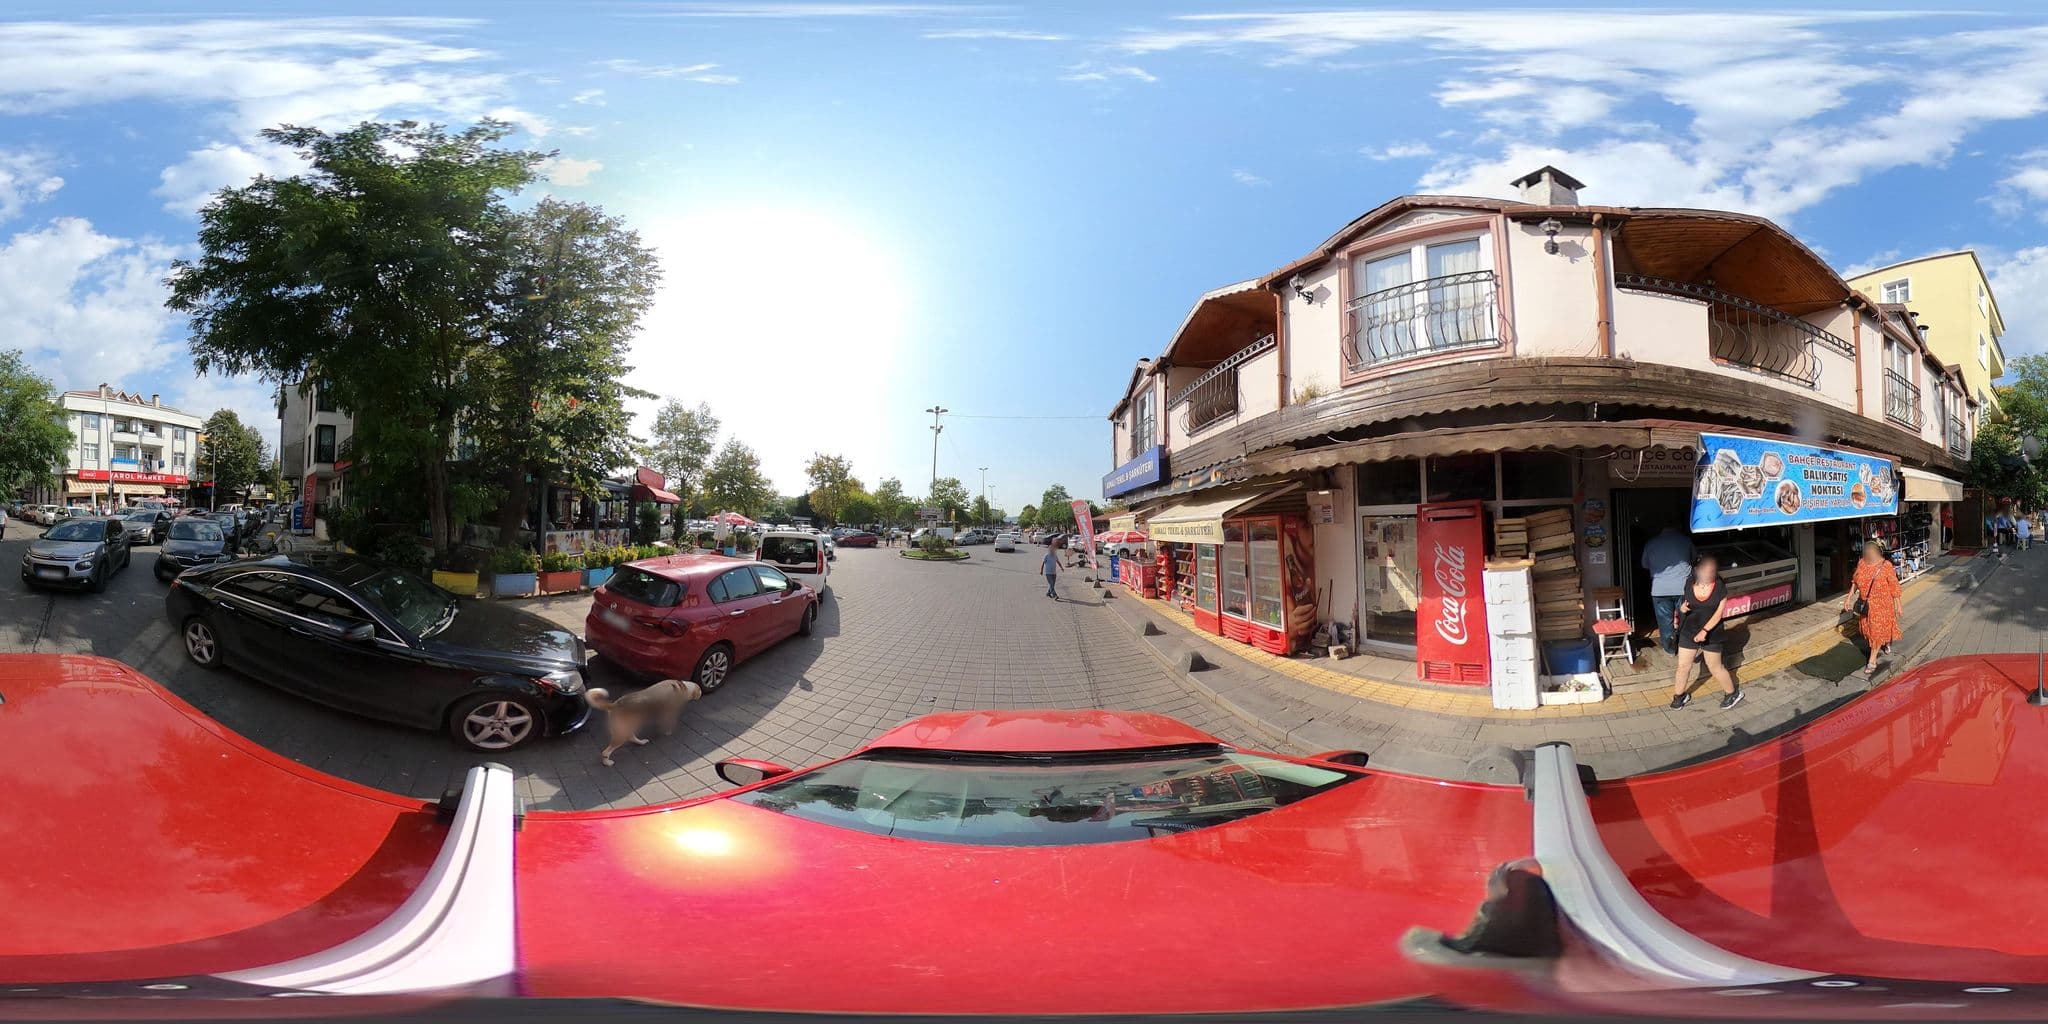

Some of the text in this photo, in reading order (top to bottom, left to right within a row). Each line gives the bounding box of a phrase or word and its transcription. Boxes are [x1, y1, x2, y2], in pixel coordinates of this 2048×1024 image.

[1788, 455, 1856, 470] BAHÇE RESTAURANT
[1803, 470, 1848, 482] BALIK SATIŞ
[1811, 484, 1843, 495] NOKTASI
[1434, 540, 1469, 645] Coca-Cola
[1726, 590, 1792, 617] restaurant
